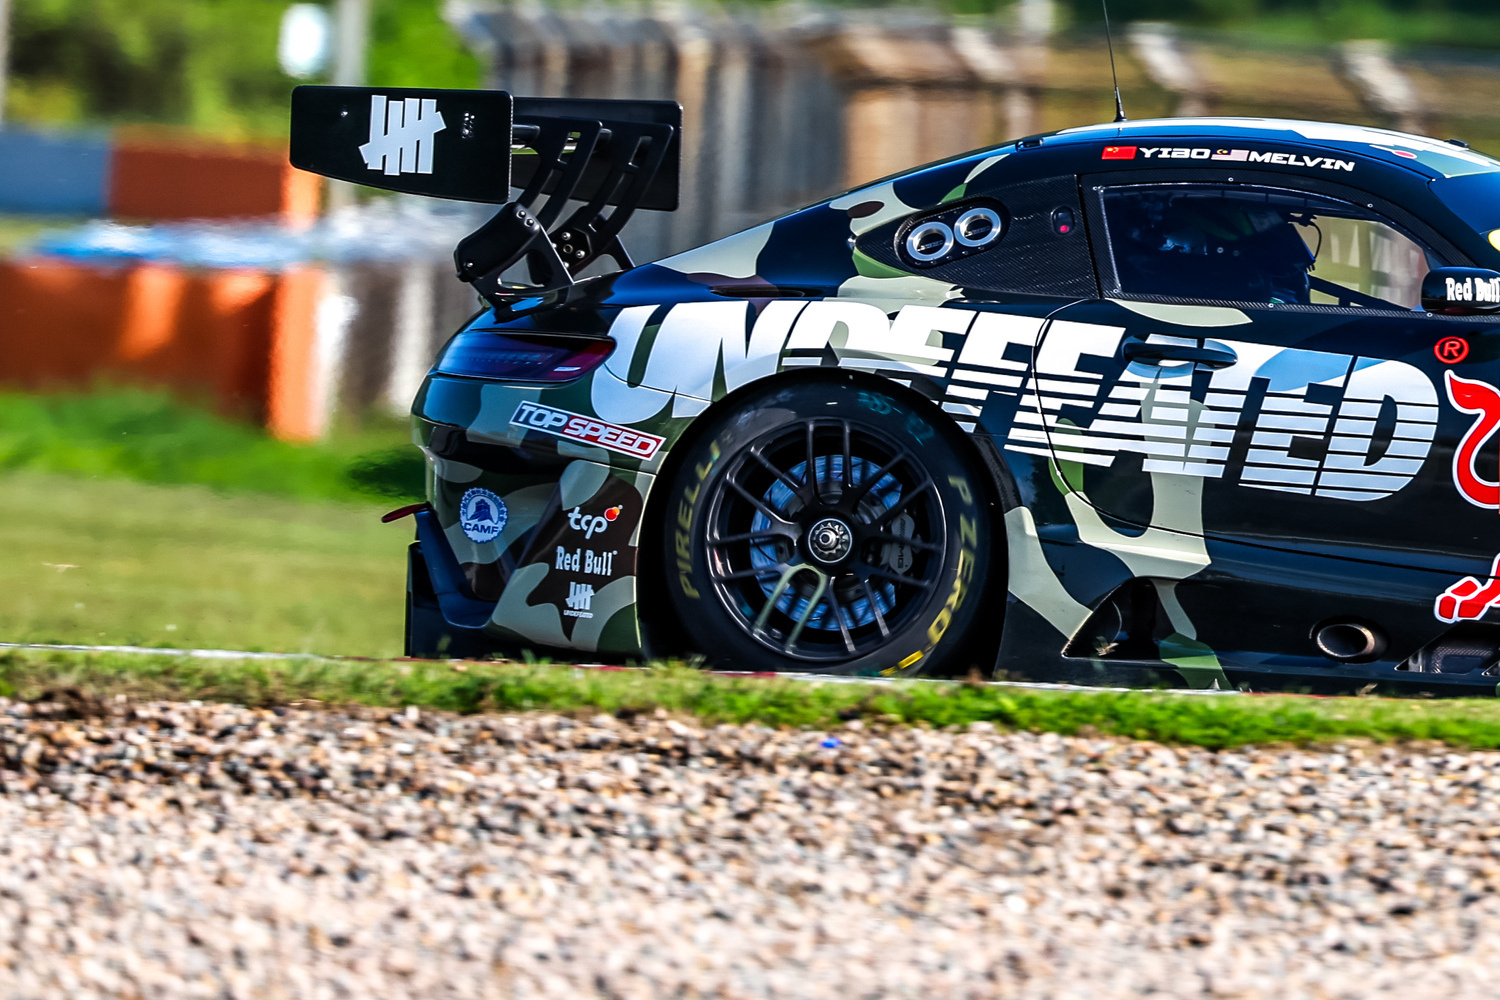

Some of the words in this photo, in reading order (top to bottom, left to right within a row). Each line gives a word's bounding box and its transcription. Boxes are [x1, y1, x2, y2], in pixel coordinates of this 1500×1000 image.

[1139, 147, 1211, 159] YIBO
[1248, 151, 1355, 172] MELVIN
[1445, 277, 1472, 302] Red
[1475, 277, 1500, 303] Bull
[516, 404, 569, 429] TOP
[563, 418, 658, 456] SPEED
[948, 475, 973, 506] P
[464, 522, 500, 535] CAMF
[567, 506, 609, 540] tcp
[555, 545, 581, 573] Red
[583, 549, 614, 577] Bull
